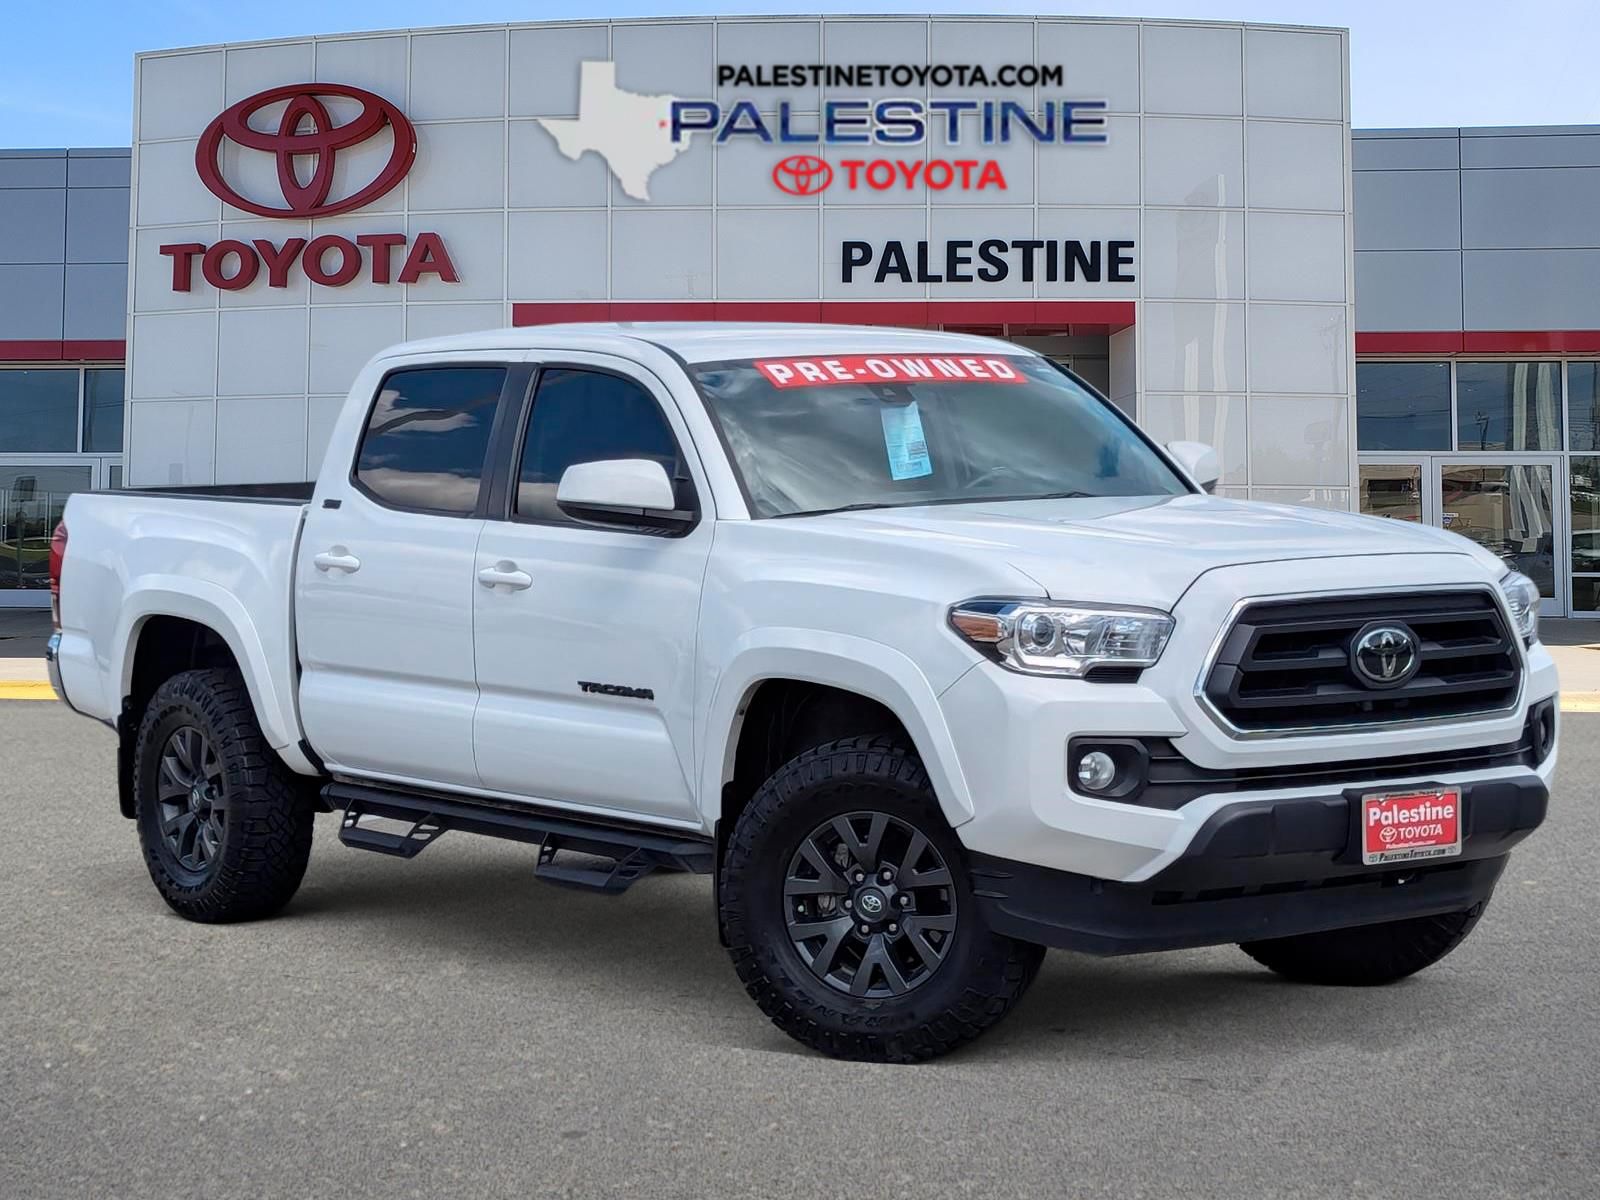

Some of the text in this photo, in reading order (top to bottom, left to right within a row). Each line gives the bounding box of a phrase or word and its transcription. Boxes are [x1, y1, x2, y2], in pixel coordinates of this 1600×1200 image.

[159, 232, 461, 293] TOYOTA
[841, 240, 1136, 283] PALESTINE
[764, 358, 1016, 384] PRE-OWNED
[1368, 801, 1455, 826] Palestine
[1398, 824, 1443, 840] TOYOTA
